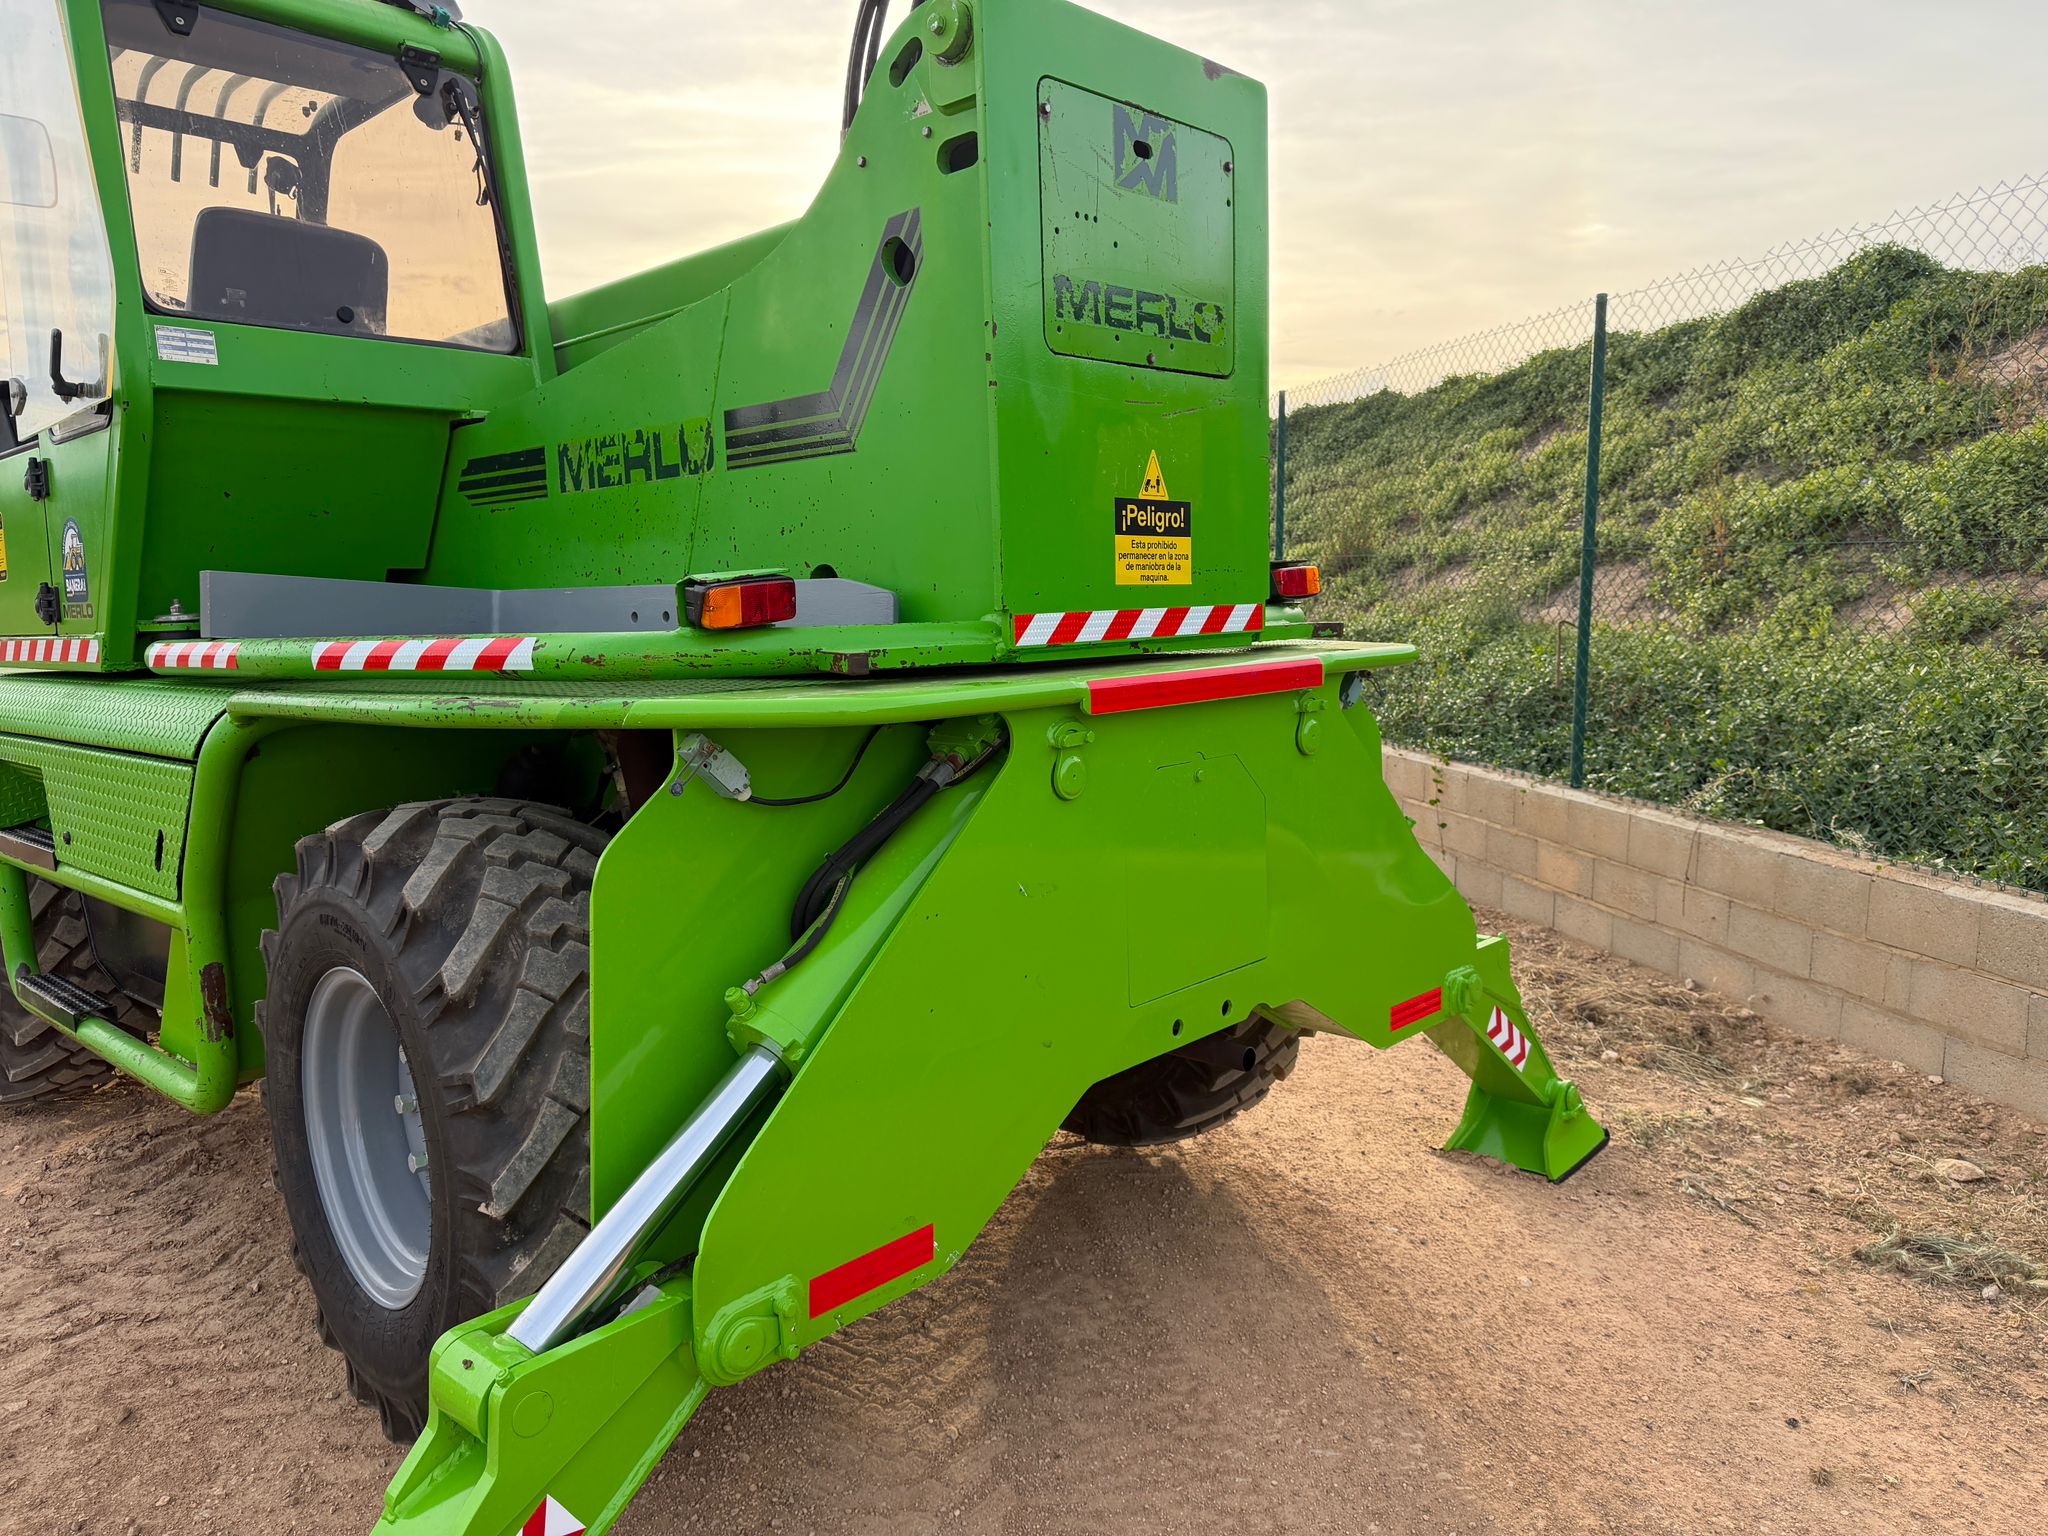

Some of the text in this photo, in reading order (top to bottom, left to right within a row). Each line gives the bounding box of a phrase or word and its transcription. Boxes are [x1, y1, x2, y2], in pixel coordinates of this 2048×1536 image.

[1053, 273, 1227, 346] MERLO
[557, 417, 715, 494] MERLO
[1122, 504, 1185, 533] ¡Peligro!
[1131, 539, 1178, 551] Esta prohibido
[1118, 552, 1158, 561] permanecer
[1167, 552, 1174, 561] la
[1174, 553, 1189, 561] zona
[1125, 562, 1182, 571] de maniobra de la
[63, 603, 94, 619] MERLO
